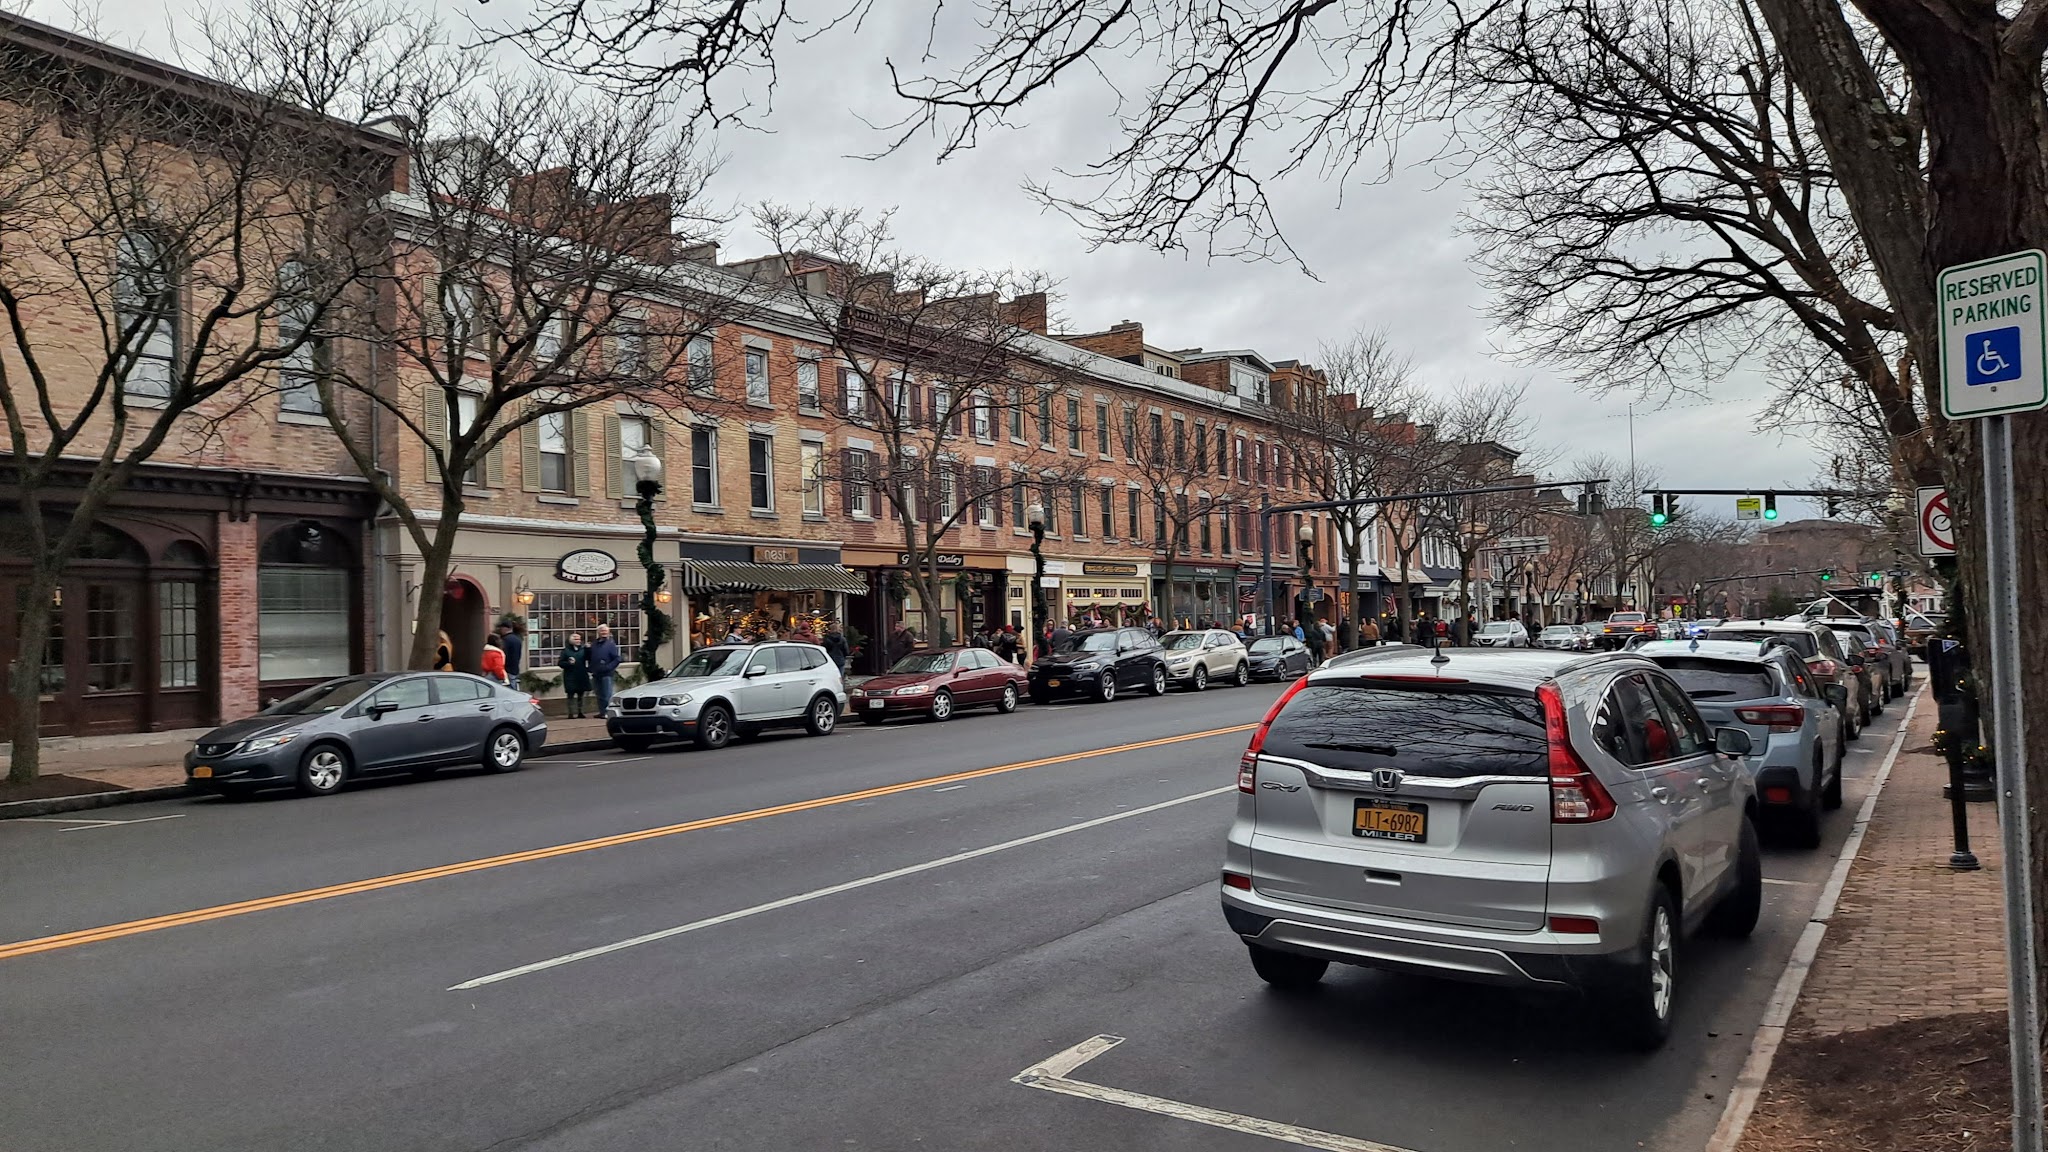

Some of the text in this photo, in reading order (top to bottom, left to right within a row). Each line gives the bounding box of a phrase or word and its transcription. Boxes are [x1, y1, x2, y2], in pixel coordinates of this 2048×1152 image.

[1946, 266, 2037, 301] RESERVED
[1953, 294, 2031, 326] PARKING
[765, 548, 786, 560] nest
[1491, 803, 1534, 811] AWD
[1361, 829, 1416, 841] MILLER
